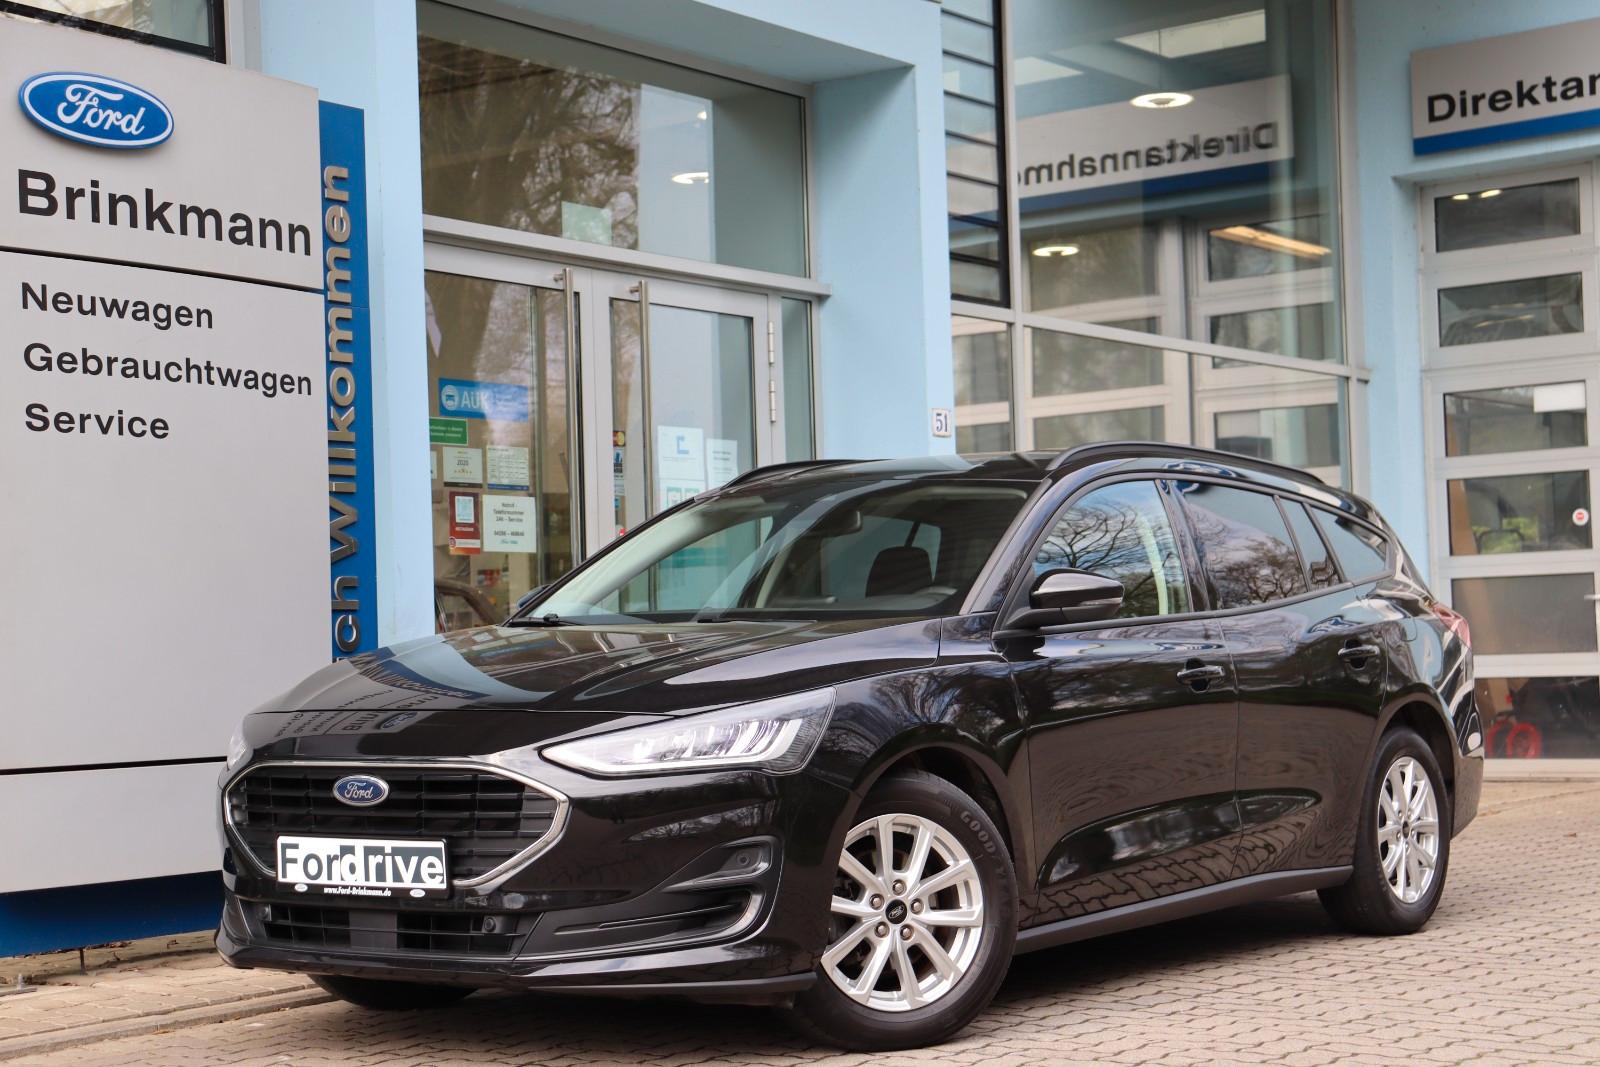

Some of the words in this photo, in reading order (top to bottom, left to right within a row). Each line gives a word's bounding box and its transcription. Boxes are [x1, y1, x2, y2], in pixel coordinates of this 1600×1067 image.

[57, 83, 147, 136] Ford
[18, 168, 312, 256] Brinkmann
[21, 281, 214, 331] Neuwagen
[23, 342, 313, 398] Gebrauchtwagen
[25, 402, 170, 439] Service
[935, 412, 948, 433] 51
[344, 781, 374, 799] Ford
[280, 842, 445, 884] Fordrive
